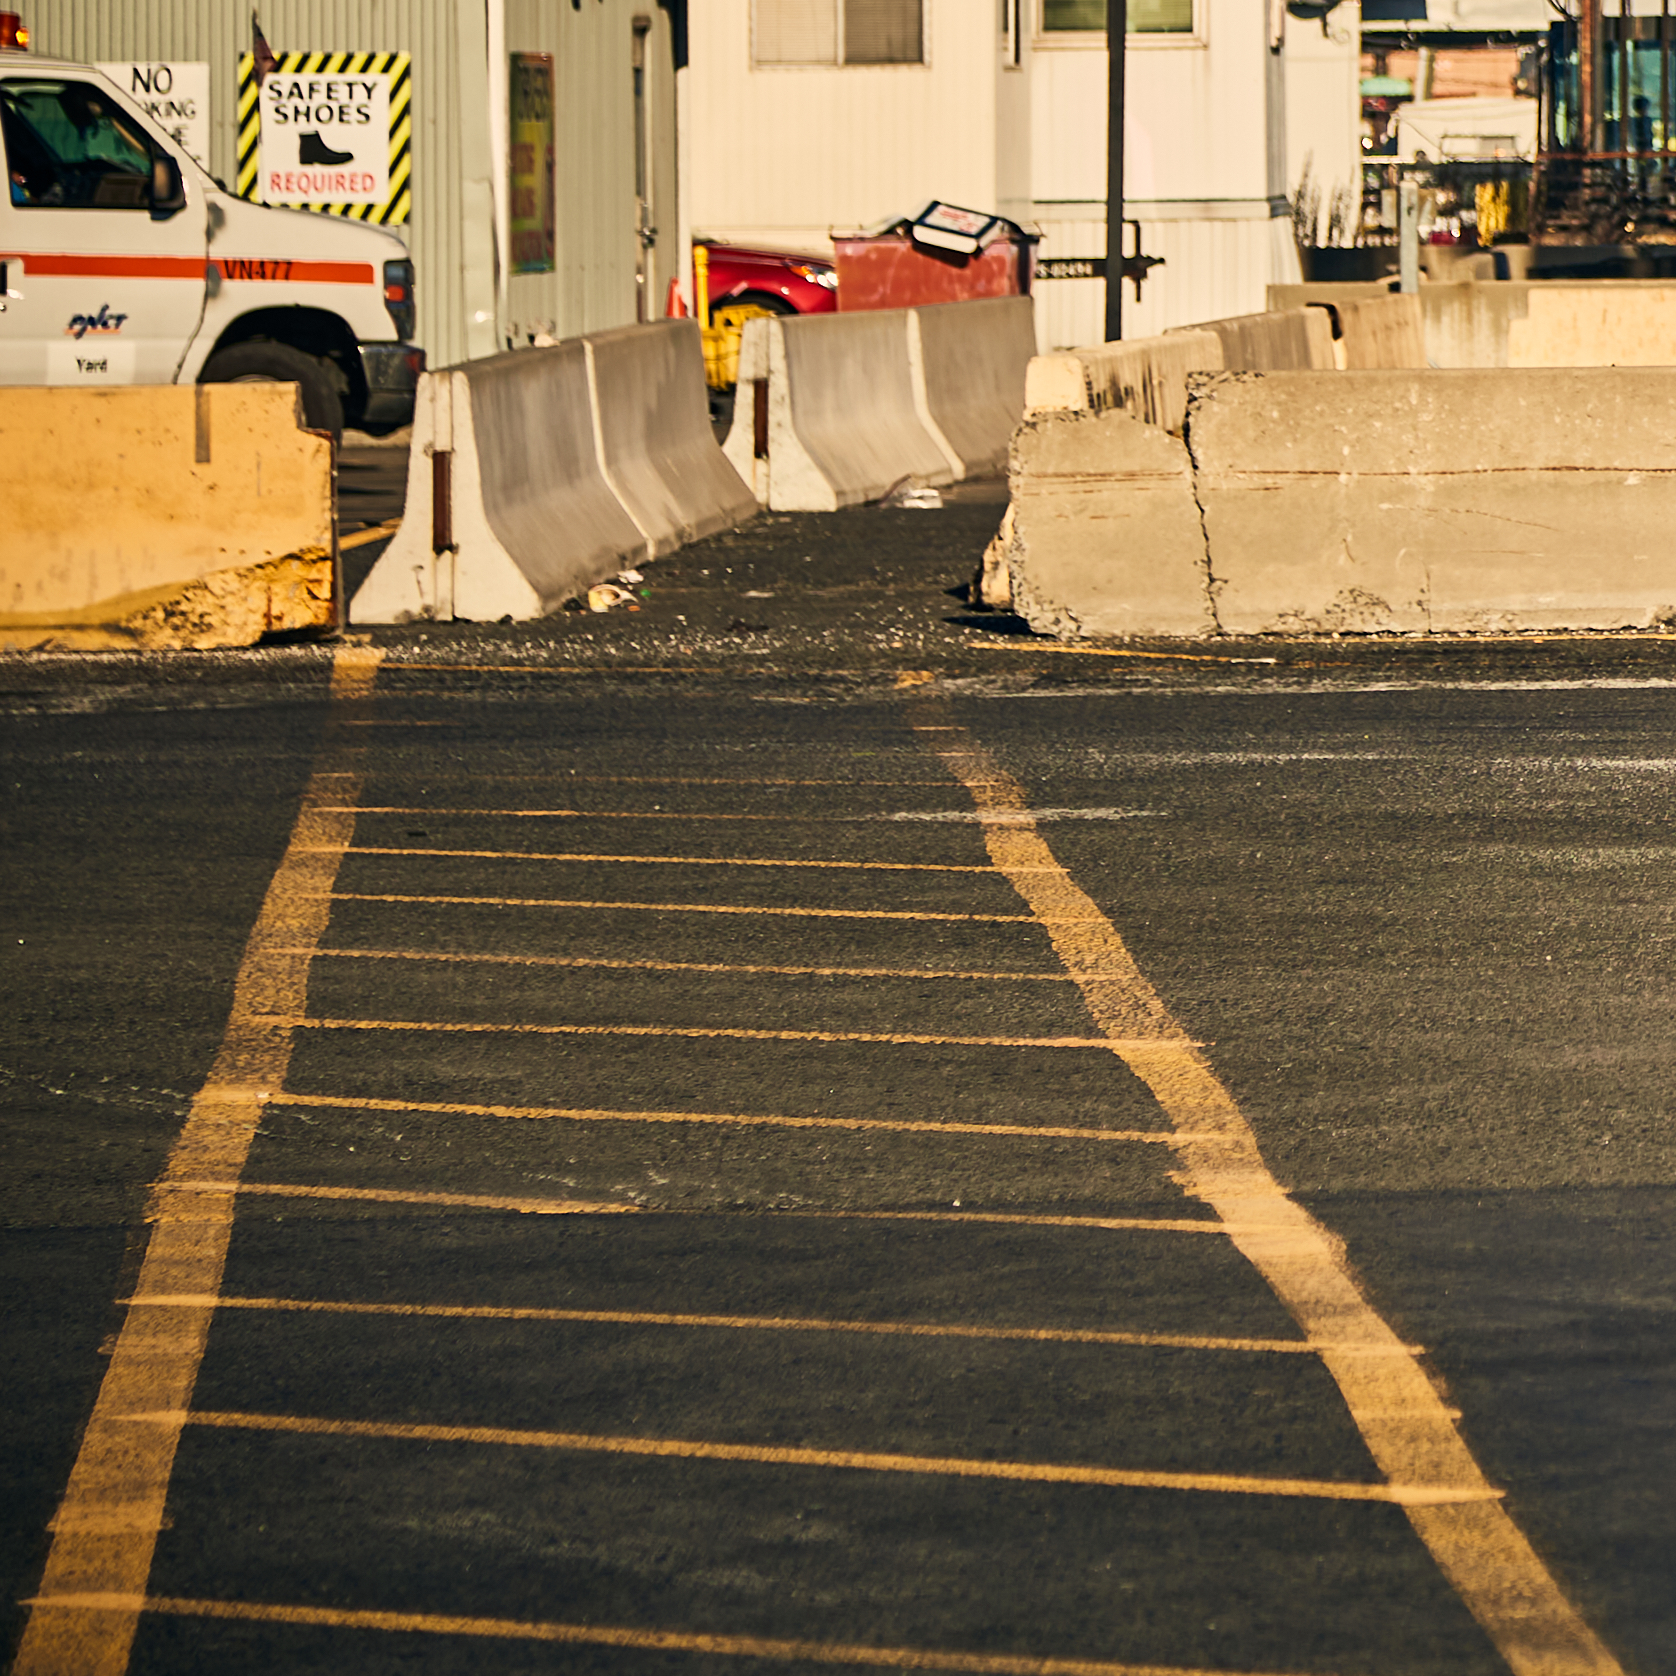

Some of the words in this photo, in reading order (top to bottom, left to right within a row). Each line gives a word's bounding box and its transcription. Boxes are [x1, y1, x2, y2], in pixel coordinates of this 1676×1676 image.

[131, 65, 173, 95] NO
[268, 81, 378, 101] SAFETY
[273, 104, 372, 124] SHOES
[270, 172, 376, 195] REQUIRED
